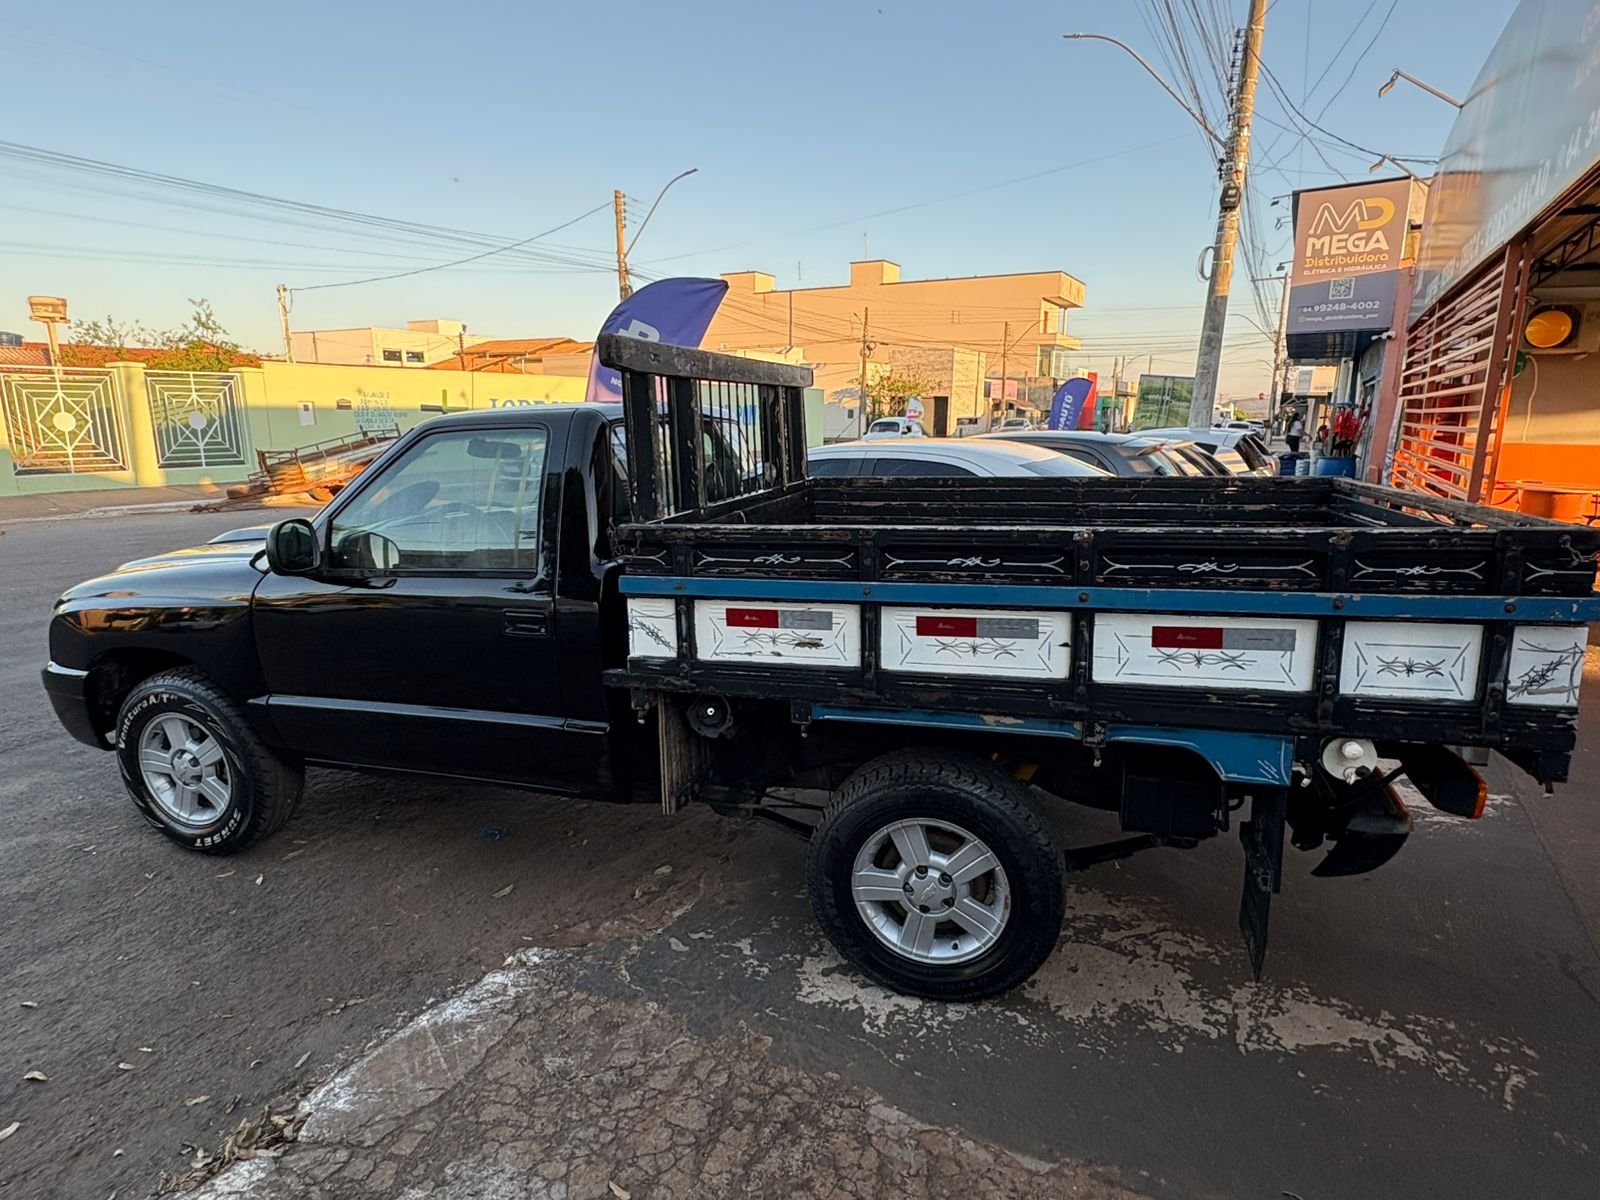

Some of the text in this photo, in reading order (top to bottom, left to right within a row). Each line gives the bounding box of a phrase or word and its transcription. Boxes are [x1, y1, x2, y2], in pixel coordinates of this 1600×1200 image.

[1305, 230, 1390, 257] MEGA
[1303, 267, 1336, 276] ELÉTRICA
[1343, 263, 1387, 272] HIDRÁULICA
[1304, 253, 1389, 268] Distribuidora
[118, 700, 148, 749] Venttura
[194, 807, 242, 847] SUNSET
